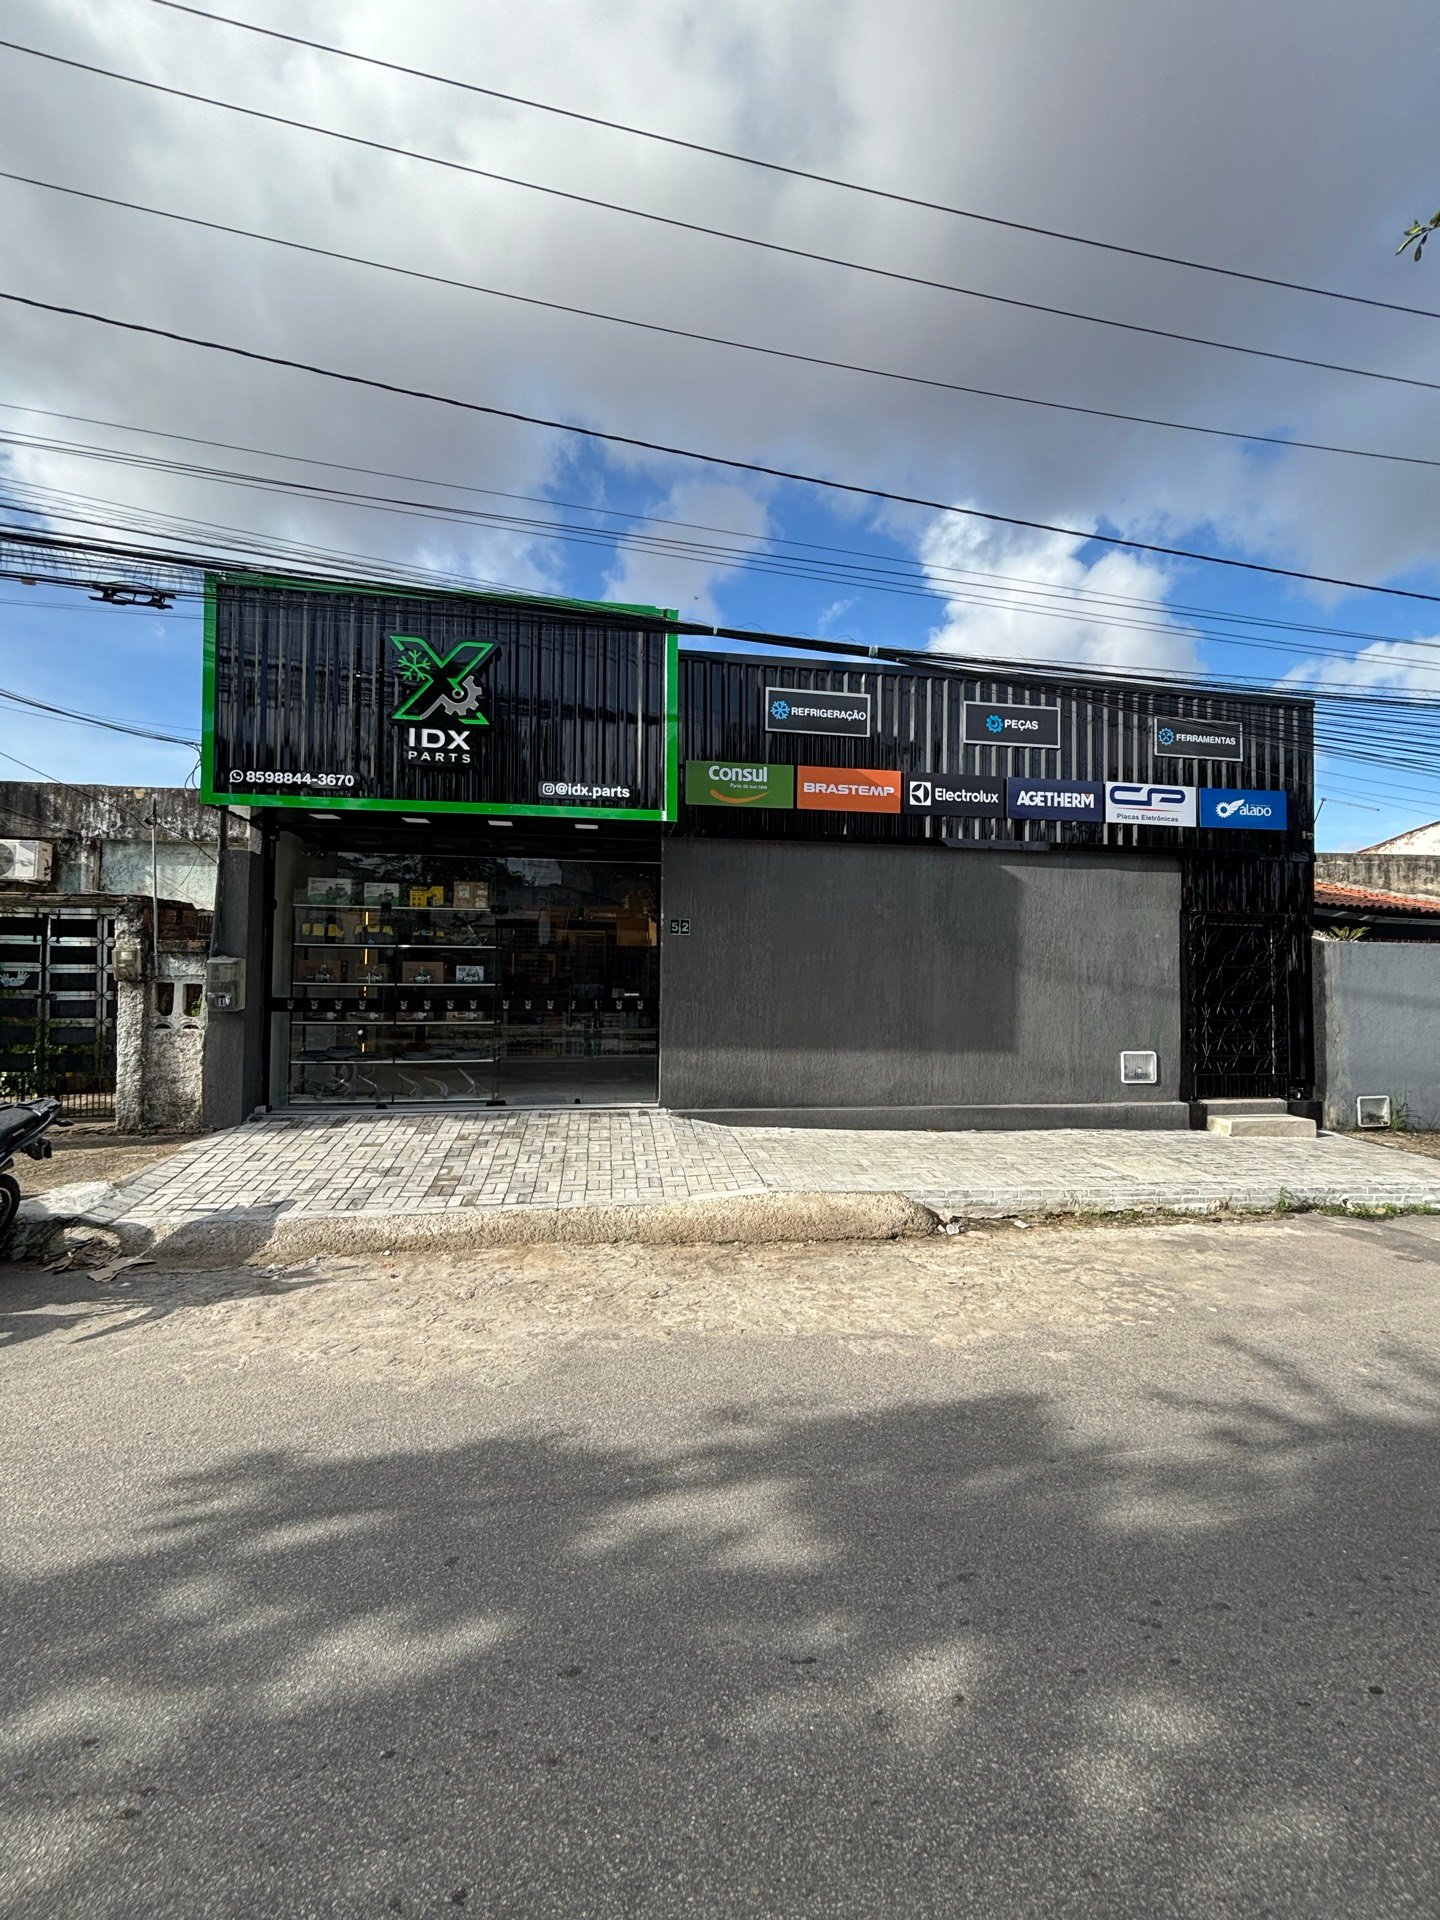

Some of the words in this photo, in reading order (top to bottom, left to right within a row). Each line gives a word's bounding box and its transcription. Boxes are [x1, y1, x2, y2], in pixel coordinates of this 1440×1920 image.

[791, 706, 867, 722] REFRIGERAÇÃO
[1004, 718, 1039, 731] PEÇAS
[408, 727, 471, 751] IDX
[1175, 733, 1237, 746] FERRAMENTAS
[408, 750, 471, 764] PARTS
[245, 770, 355, 787] 8598844-3670
[708, 765, 768, 783] Consul
[555, 782, 630, 799] @idx.parts
[803, 782, 895, 797] BRASTEMP
[934, 787, 999, 804] Electrolux
[1016, 790, 1095, 809] AGETHERM
[1141, 814, 1179, 823] Eletrônicas
[671, 922, 689, 932] 52
